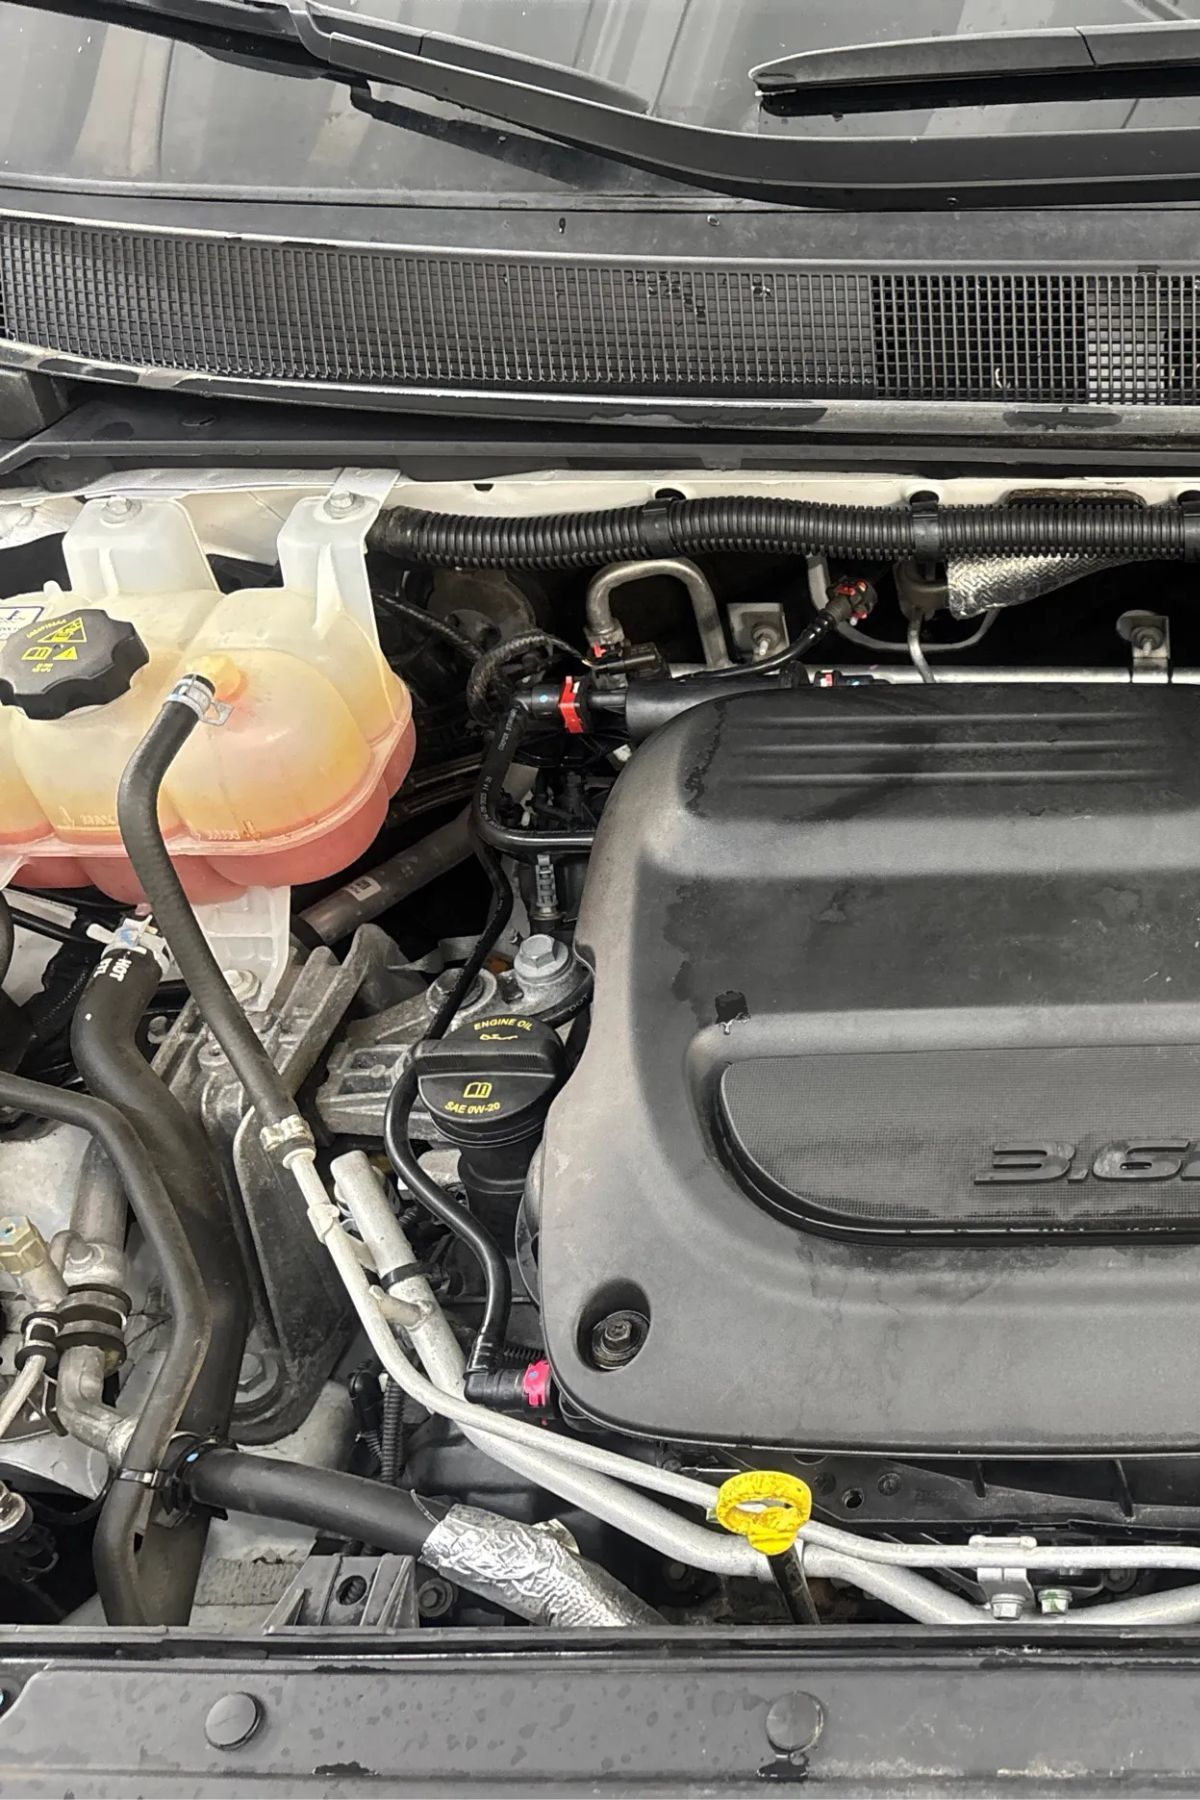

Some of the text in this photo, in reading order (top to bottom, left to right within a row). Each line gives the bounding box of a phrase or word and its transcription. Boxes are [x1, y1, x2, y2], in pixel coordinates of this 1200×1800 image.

[473, 1018, 534, 1031] ENGINE OIL
[444, 1101, 501, 1114] SAE 0W-20
